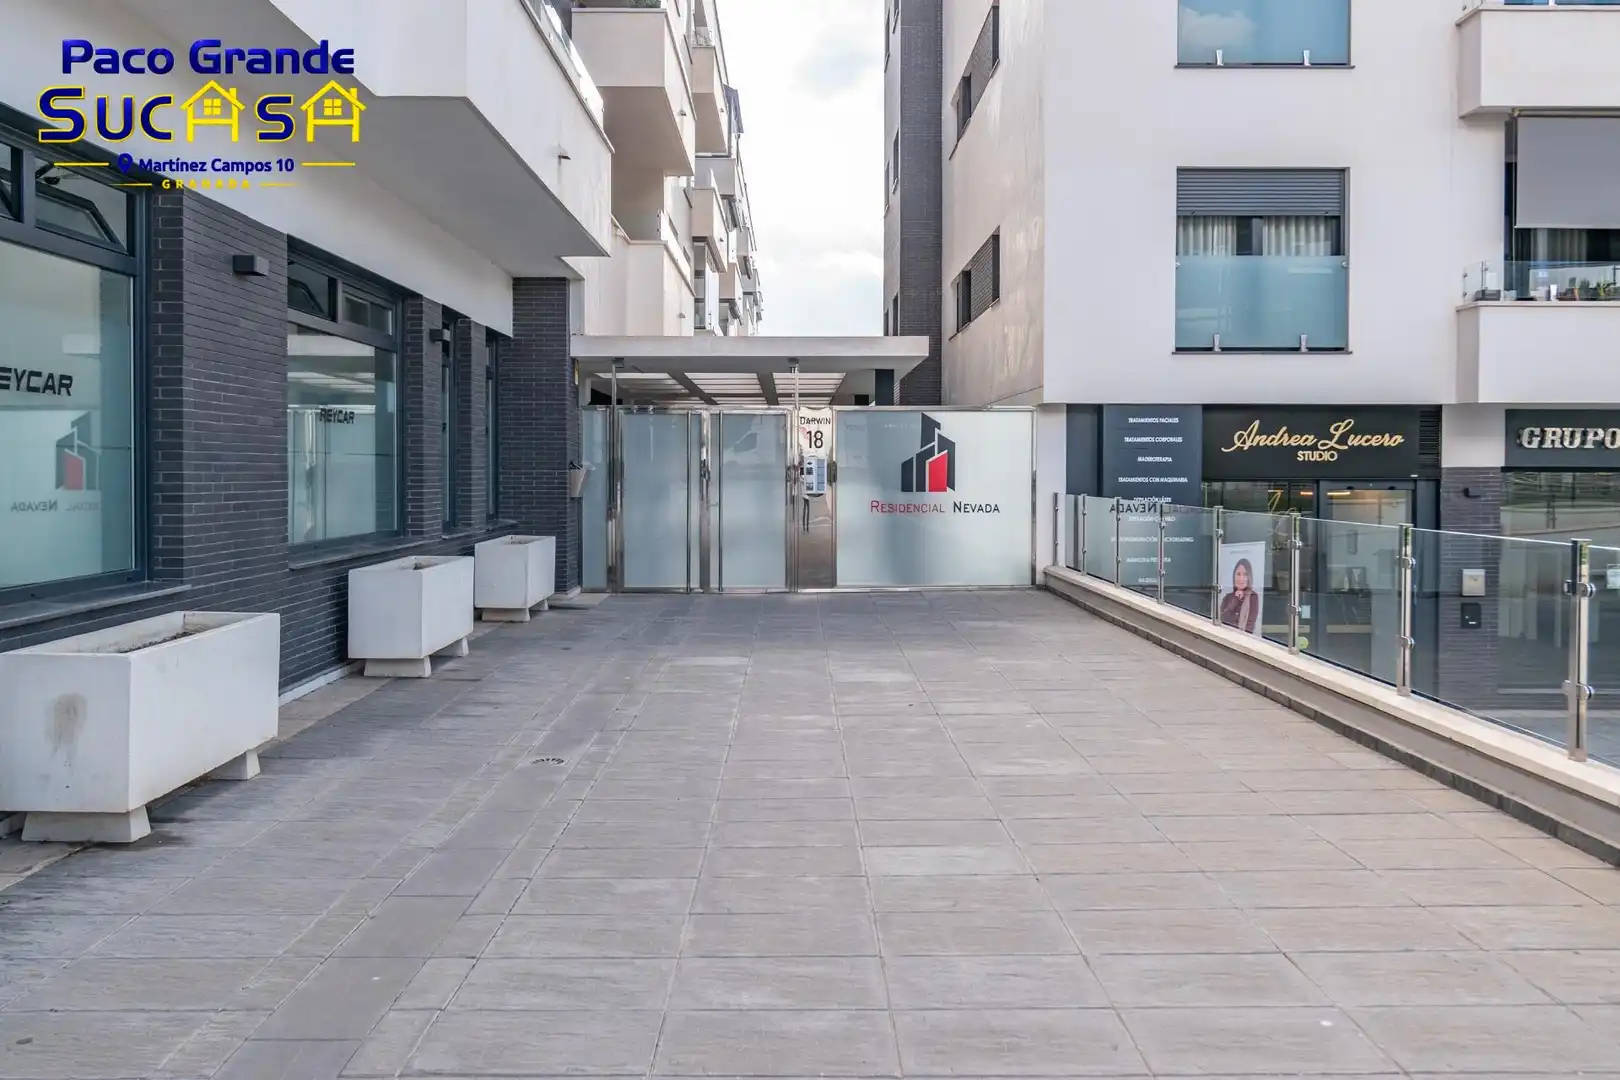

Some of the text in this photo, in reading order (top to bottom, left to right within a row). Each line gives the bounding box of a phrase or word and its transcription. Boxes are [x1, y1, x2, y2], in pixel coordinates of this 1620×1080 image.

[800, 416, 831, 425] DARWIN
[807, 430, 824, 449] 18
[1221, 419, 1405, 452] Andrea Lucero
[1521, 427, 1620, 449] GRUPO
[1296, 450, 1339, 462] STUDIO
[869, 500, 1000, 514] RESIDENCIAL NEVADA
